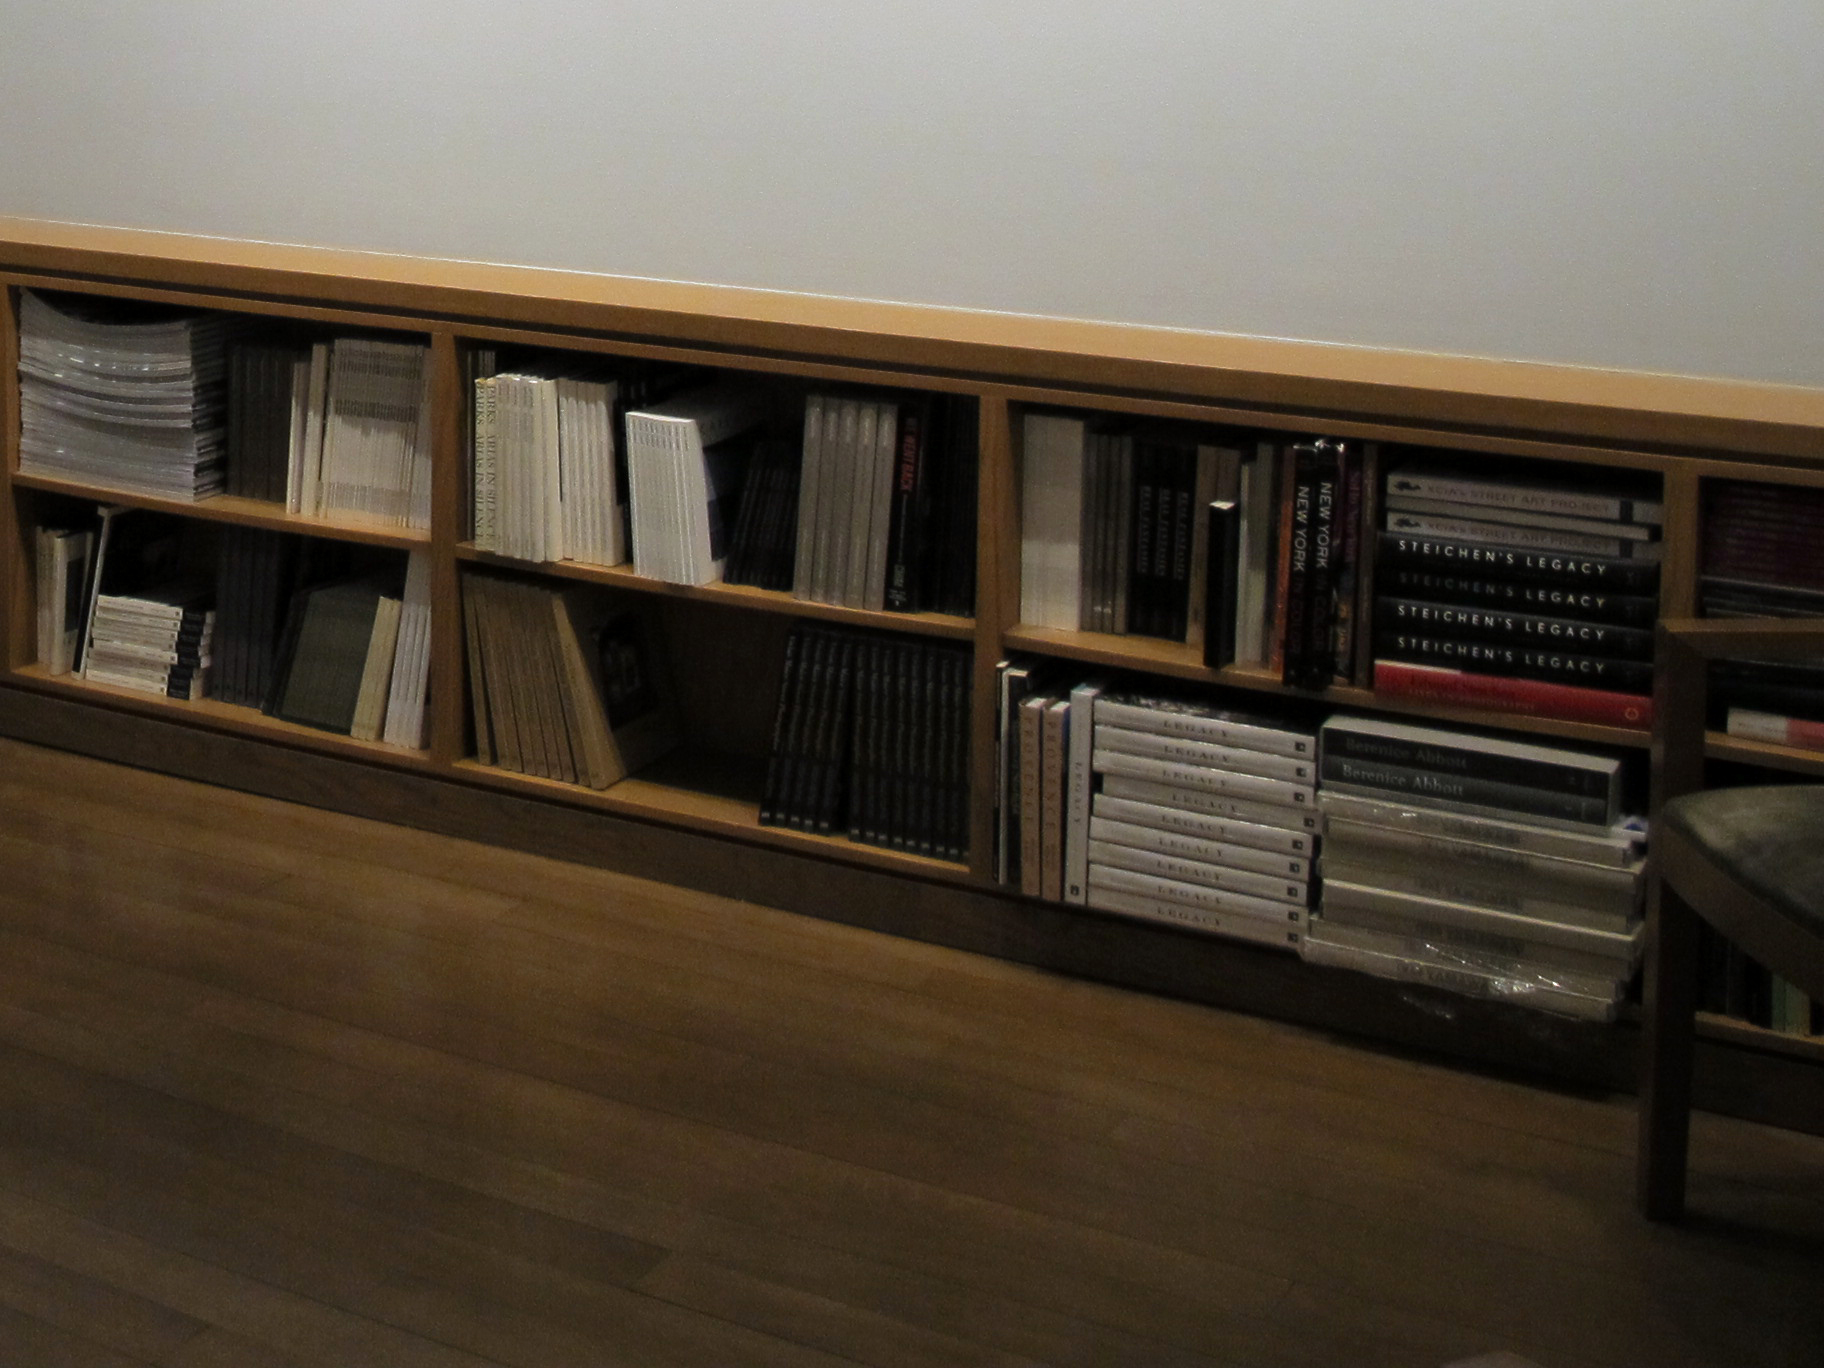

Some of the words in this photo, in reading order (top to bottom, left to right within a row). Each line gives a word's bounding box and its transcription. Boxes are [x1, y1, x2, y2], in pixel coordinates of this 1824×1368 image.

[1296, 486, 1310, 524] NEW
[1319, 482, 1332, 521] NEW
[1293, 529, 1308, 572] YORK
[1316, 524, 1331, 569] YORK
[1398, 540, 1514, 564] STEICHEN'S
[1526, 550, 1606, 576] LEGACY
[1526, 583, 1606, 609] LEGACY
[1398, 604, 1513, 630] STEICHEN'S
[1526, 620, 1606, 642] LEGACY
[1398, 636, 1513, 663] STEICHEN'S
[1526, 650, 1605, 674] LEGACY
[1163, 720, 1228, 738] LEGACY
[1164, 744, 1229, 762] LEGACY
[1346, 736, 1410, 762] Berenice
[1416, 748, 1467, 768] Abbott
[1046, 720, 1056, 830] PROVENCE
[1162, 768, 1228, 788] LEGACY
[1342, 764, 1406, 787] Berenice
[1412, 775, 1464, 796] Abbott
[1074, 761, 1083, 826] LEGACY
[1172, 792, 1237, 812] LEGACY
[1162, 814, 1227, 833] LEGACY
[1158, 837, 1223, 858] LEGACY
[1157, 860, 1222, 882] LEGACY
[1158, 884, 1222, 905] LEGACY
[1156, 906, 1222, 926] LEGACY
